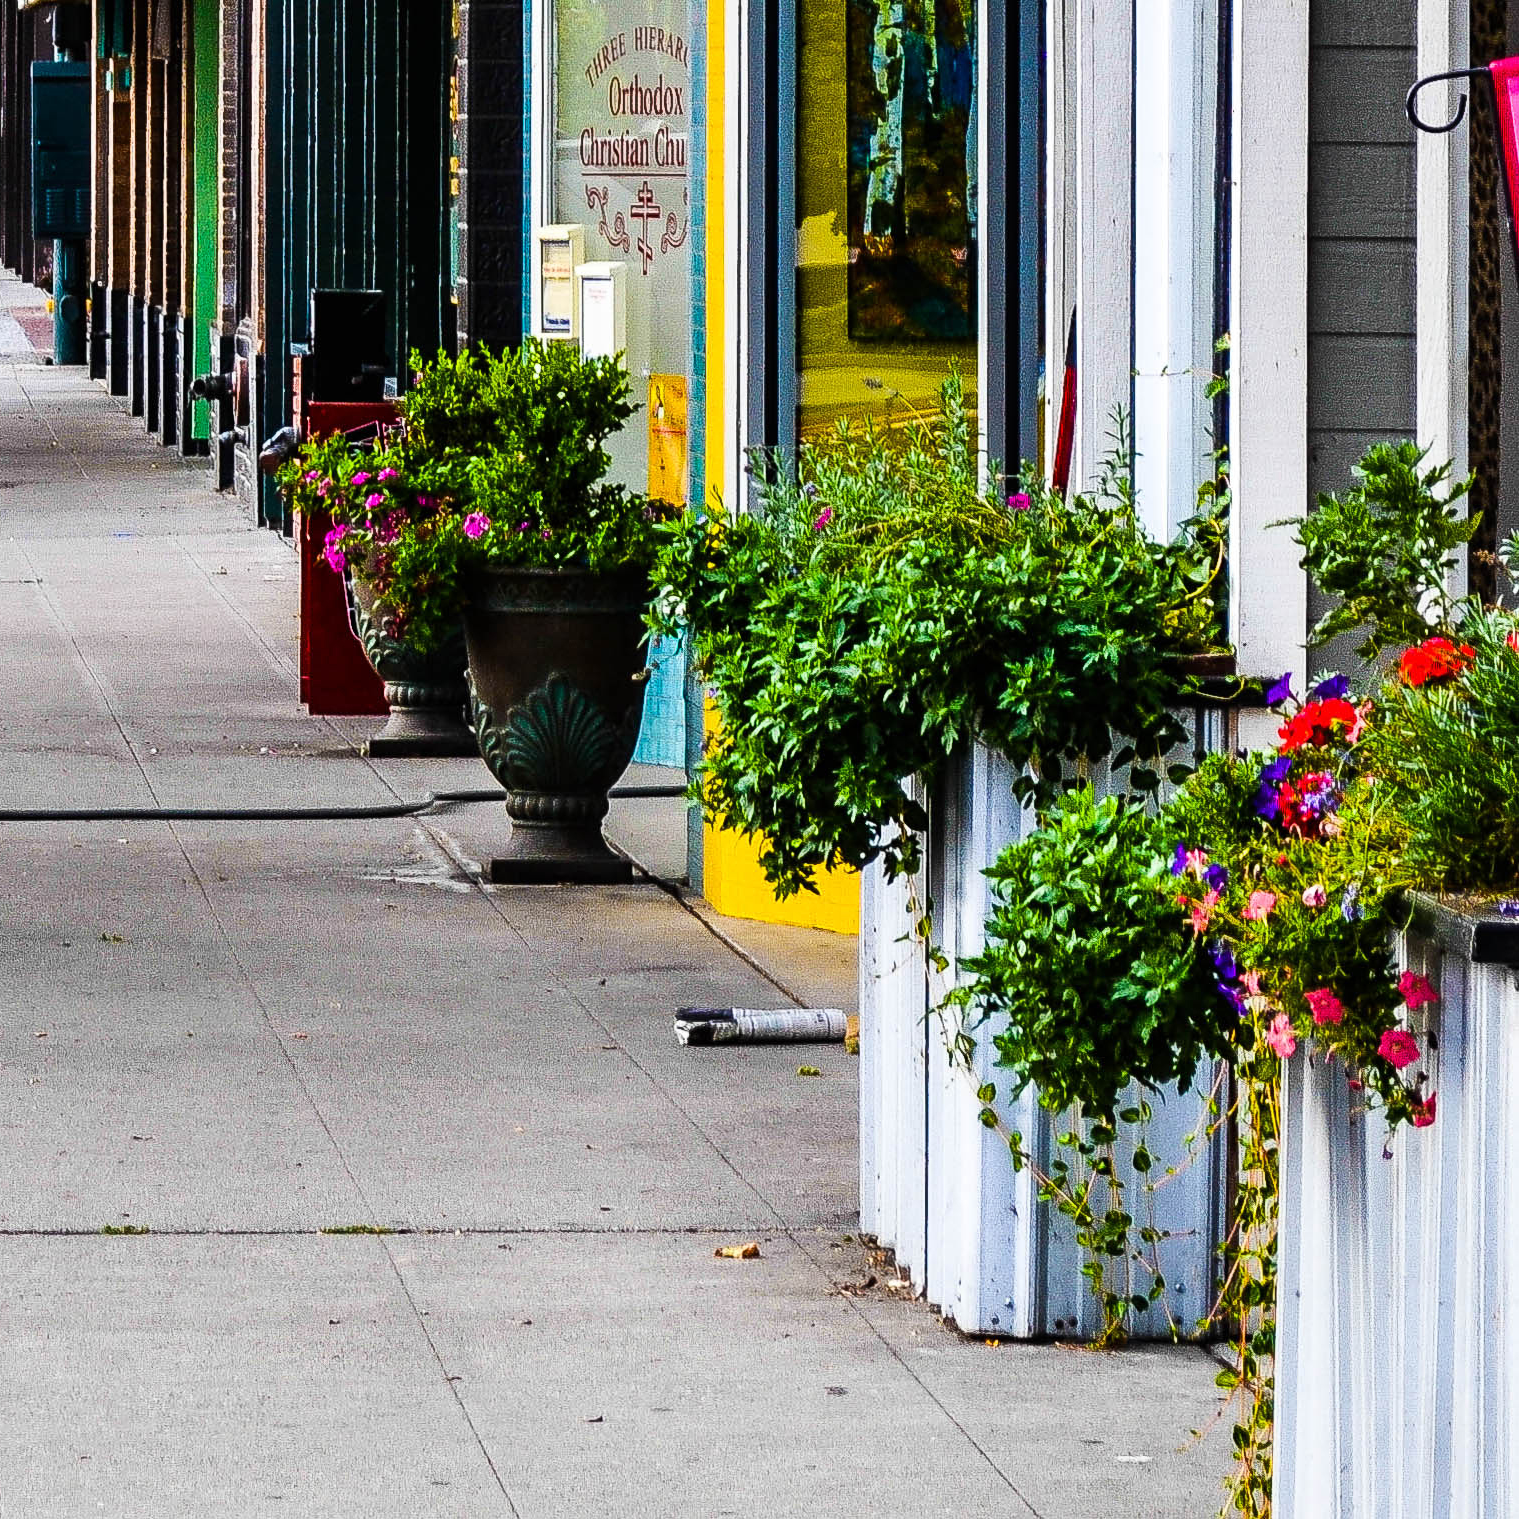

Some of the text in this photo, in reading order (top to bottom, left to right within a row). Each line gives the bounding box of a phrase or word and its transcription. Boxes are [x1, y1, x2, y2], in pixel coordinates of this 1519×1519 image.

[585, 33, 625, 88] THREE
[610, 74, 683, 116] Orthodox
[580, 127, 685, 167] Christian Chu
